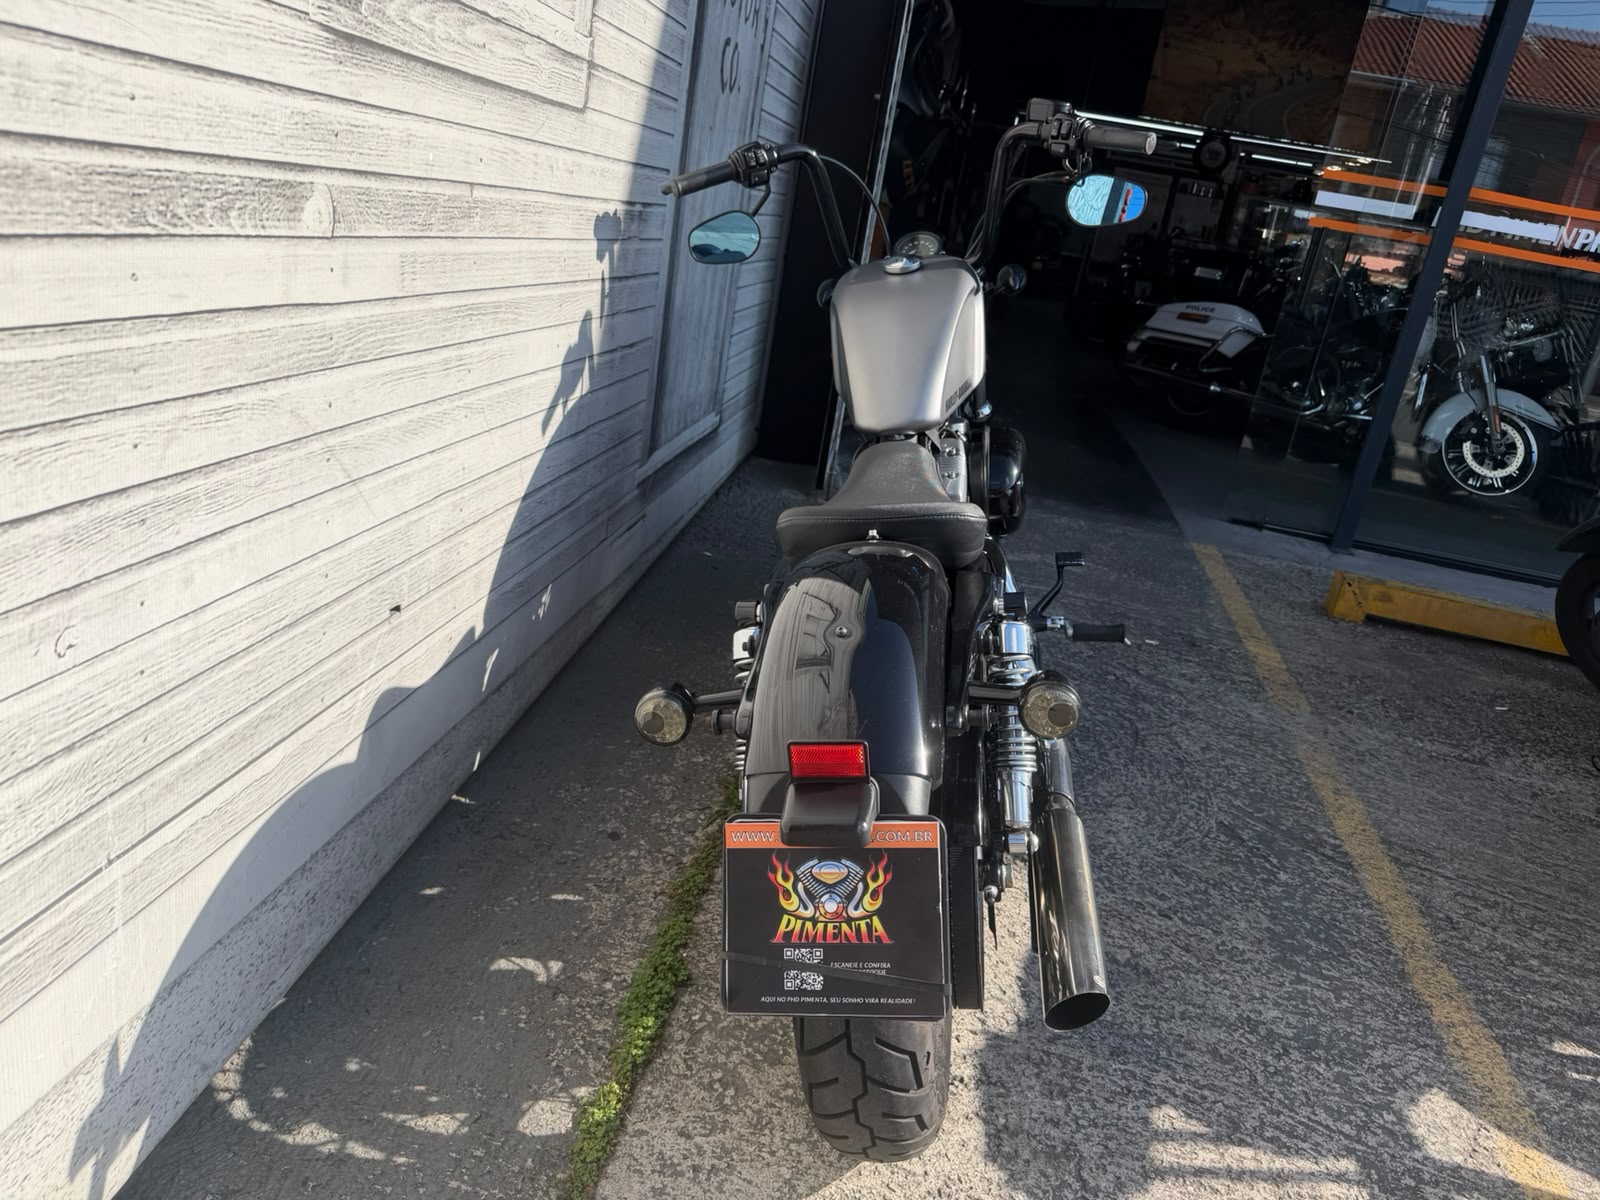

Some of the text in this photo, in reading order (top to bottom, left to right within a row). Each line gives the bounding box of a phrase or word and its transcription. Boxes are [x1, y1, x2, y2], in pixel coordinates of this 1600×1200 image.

[720, 37, 741, 95] CO.
[1184, 304, 1216, 313] POLICE
[769, 914, 895, 944] PIMENTA
[830, 961, 858, 969] ESCANEIE
[864, 961, 892, 969] CONFIRA
